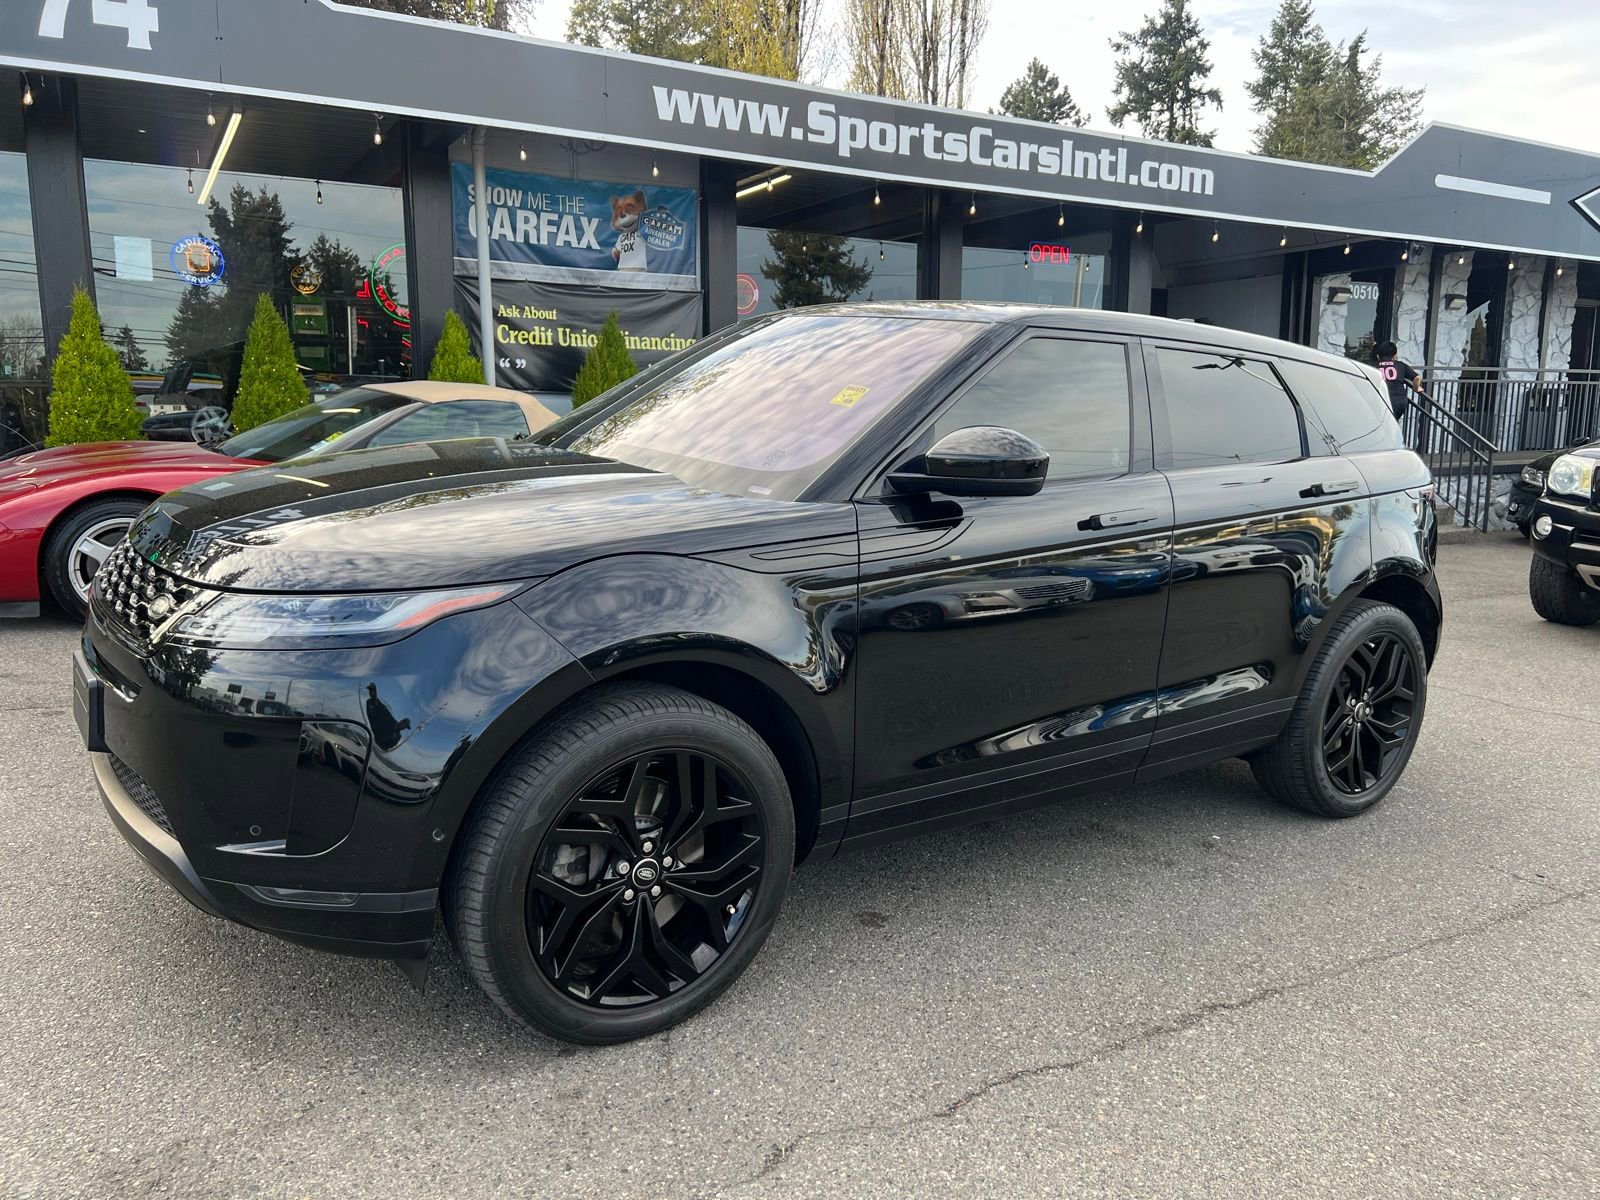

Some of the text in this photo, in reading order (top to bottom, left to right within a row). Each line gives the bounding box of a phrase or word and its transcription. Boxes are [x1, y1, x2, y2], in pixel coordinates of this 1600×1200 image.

[527, 191, 552, 211] ME
[555, 195, 585, 215] THE
[468, 204, 601, 250] CARFAX
[643, 217, 683, 235] CARFAX
[645, 227, 678, 243] ADVANTAGE
[175, 237, 221, 257] CADILLAC
[620, 241, 635, 253] FOX
[647, 235, 671, 248] DEALER
[1030, 244, 1070, 265] OPEN
[180, 270, 218, 284] SERVICE
[497, 304, 557, 321] Ask About
[496, 324, 696, 351] Credit Unio inancing
